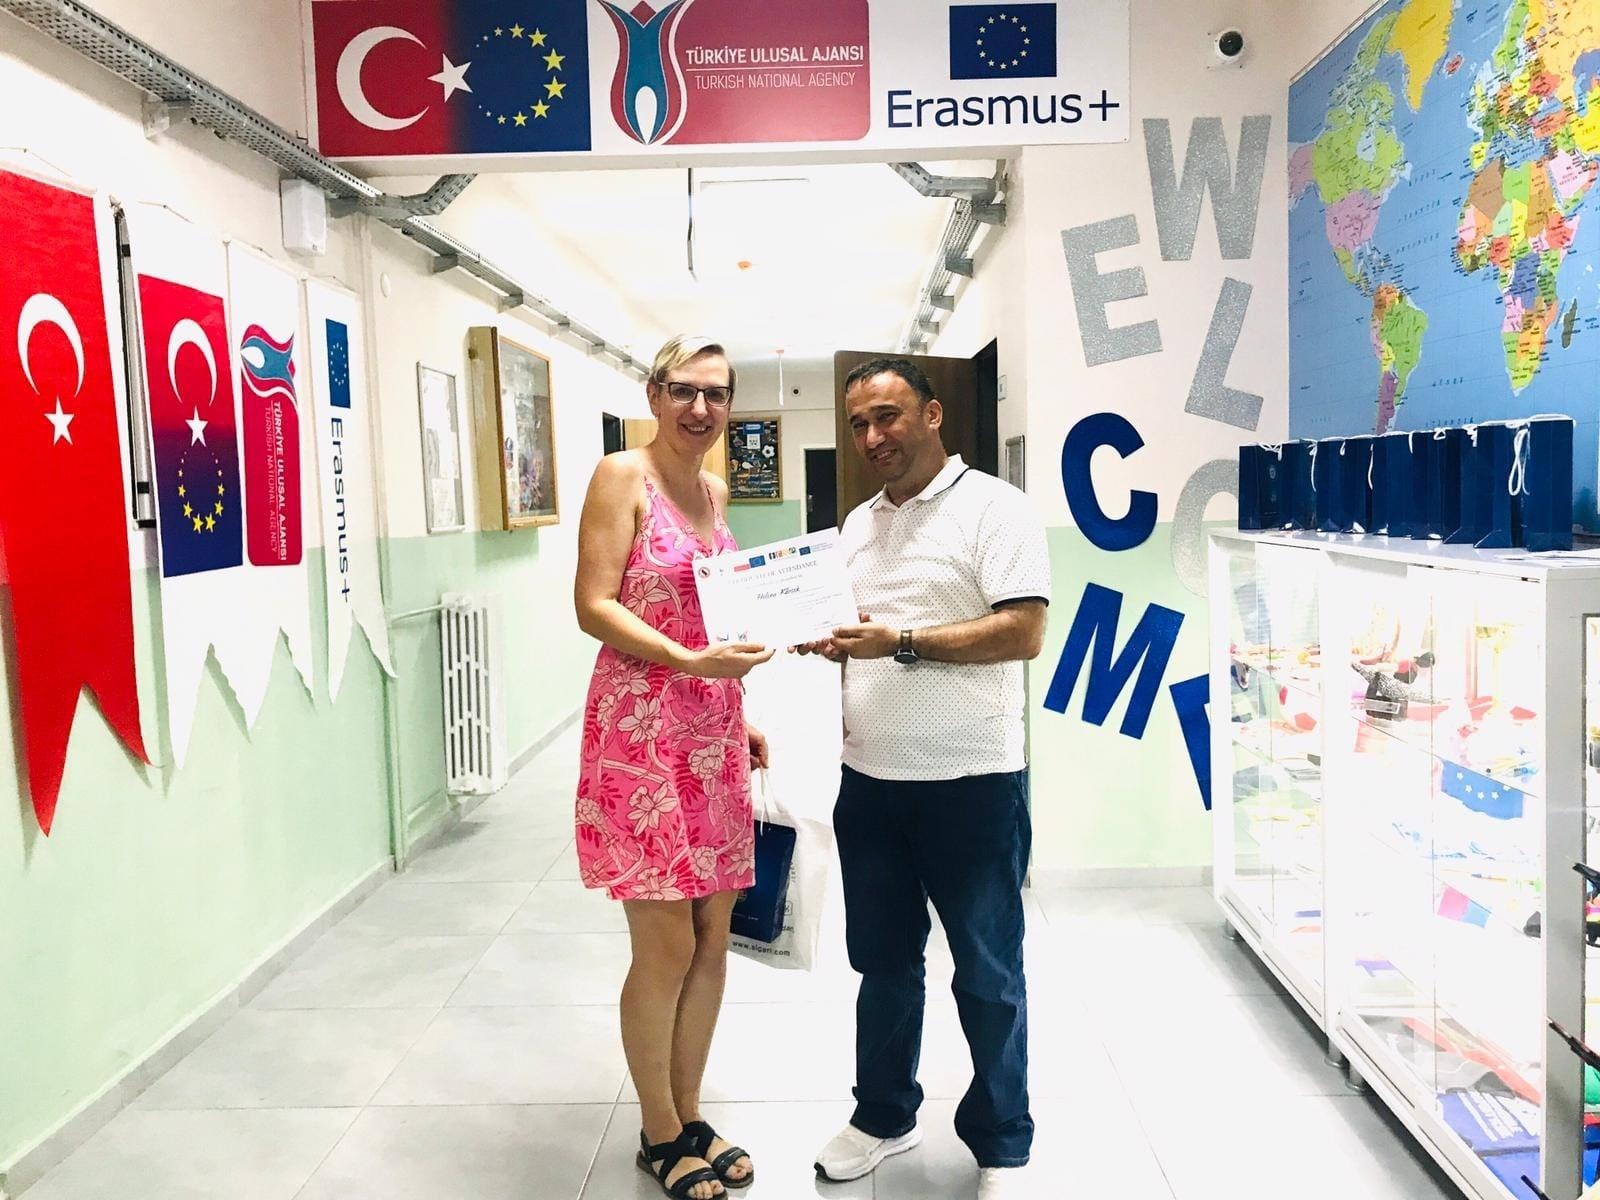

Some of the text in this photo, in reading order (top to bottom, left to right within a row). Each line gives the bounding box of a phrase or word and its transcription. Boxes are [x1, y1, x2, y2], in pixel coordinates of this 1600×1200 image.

[685, 45, 864, 66] TÜRKİYE ULUSAL AJANSI
[695, 71, 857, 90] TURKISH NATIONAL AGENCY
[886, 89, 1120, 129] Erasmus+
[264, 407, 273, 451] TURKISH
[266, 455, 275, 505] NATIONAL
[273, 401, 287, 561] TÜRKİYE ULUSAL AJANSI
[331, 417, 351, 603] Erasmus+
